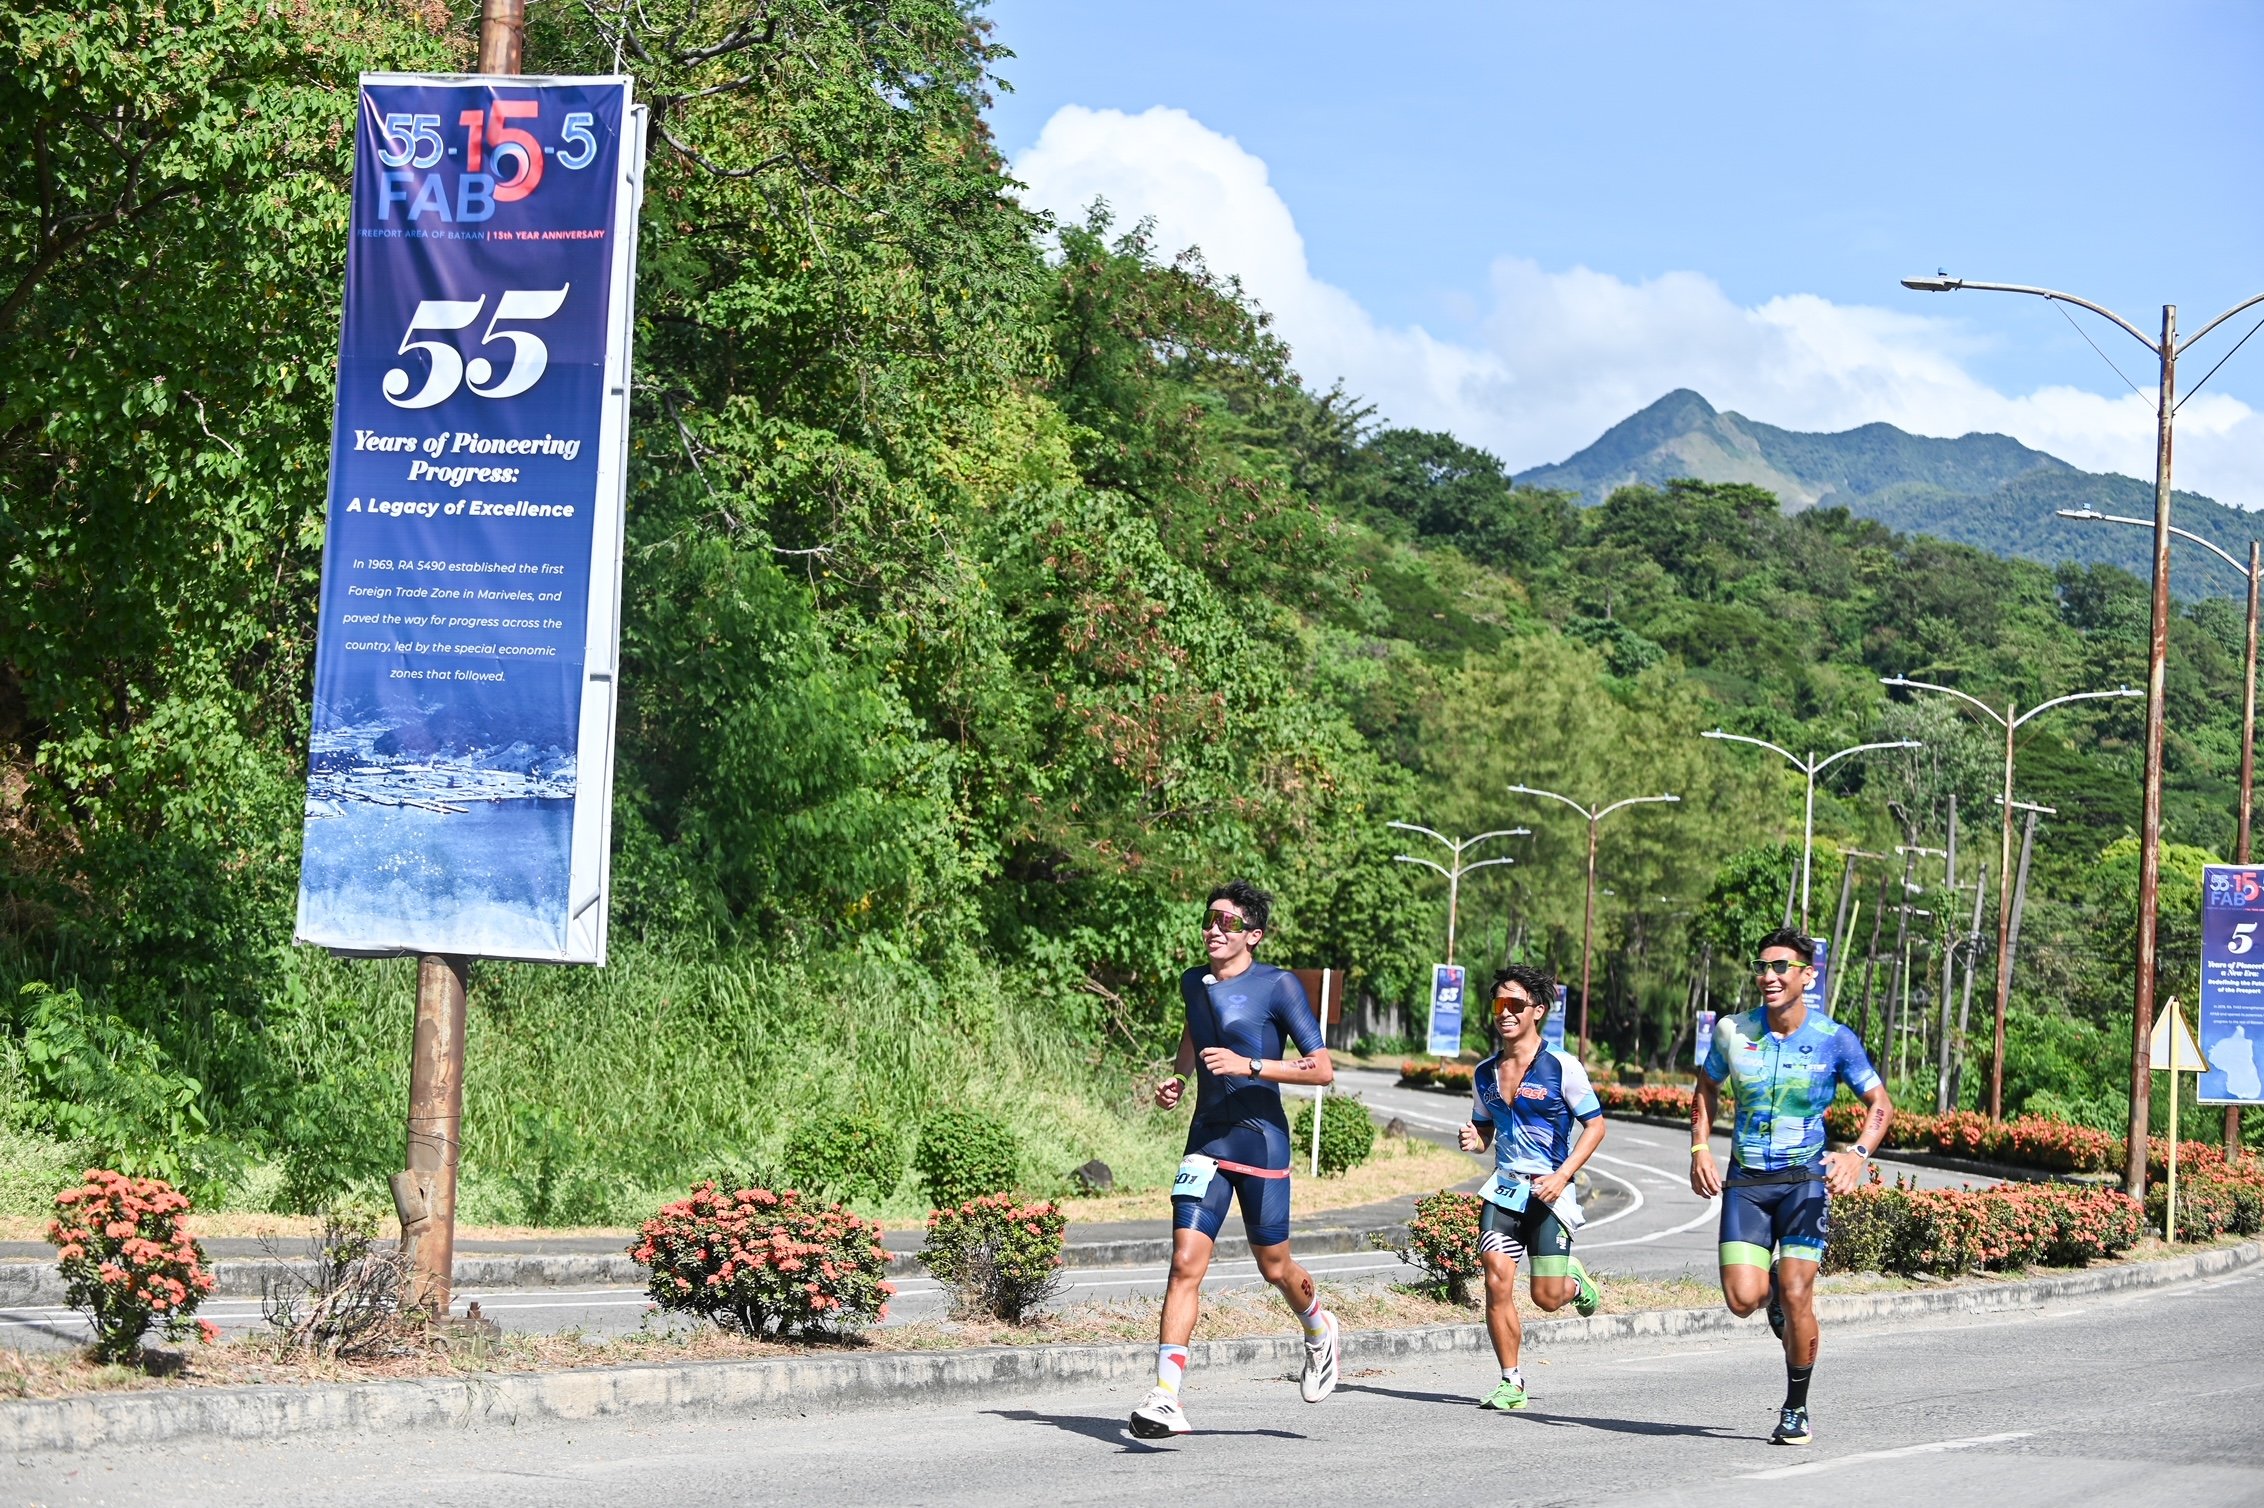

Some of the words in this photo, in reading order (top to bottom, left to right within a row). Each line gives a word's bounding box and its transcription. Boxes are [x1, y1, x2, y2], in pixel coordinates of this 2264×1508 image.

[377, 171, 496, 223] FAB
[357, 229, 402, 239] FREEPORT
[405, 230, 428, 238] AREA
[432, 230, 446, 238] OF
[448, 231, 485, 240] BATAAN
[493, 231, 513, 240] 15th
[516, 231, 540, 240] YEAR
[542, 230, 606, 240] ANNIVERSARY
[382, 282, 570, 409] 55
[353, 429, 418, 452] Years
[422, 432, 450, 459] of
[450, 432, 580, 461] Pioneering
[407, 460, 520, 488] Progress:
[346, 498, 362, 513] A
[367, 498, 438, 518] Legacy
[444, 498, 466, 515] of
[469, 500, 575, 518] Excellence
[353, 559, 365, 570] In
[368, 559, 395, 571] 1969,
[398, 560, 414, 570] RA
[416, 560, 446, 571] 5490
[448, 560, 516, 574] established
[518, 562, 538, 574] the
[541, 563, 564, 574] first
[348, 586, 392, 600] Foreign
[396, 587, 428, 598] Trade
[430, 588, 460, 599] Zone
[462, 588, 474, 599] in
[478, 590, 535, 602] Mariveles,
[538, 590, 562, 602] and
[342, 614, 380, 625] paved
[382, 614, 402, 624] the
[404, 615, 428, 627] way
[430, 614, 446, 626] for
[448, 616, 499, 629] progress
[502, 618, 540, 628] across
[542, 618, 562, 629] the
[345, 640, 392, 653] country,
[394, 640, 412, 652] led
[416, 642, 430, 654] by
[432, 642, 451, 653] the
[454, 643, 496, 656] special
[498, 645, 556, 656] economic
[390, 669, 423, 679] zones
[426, 669, 451, 680] that
[454, 669, 506, 682] followed.
[2211, 891, 2246, 906] FAB
[2228, 922, 2258, 954] 5
